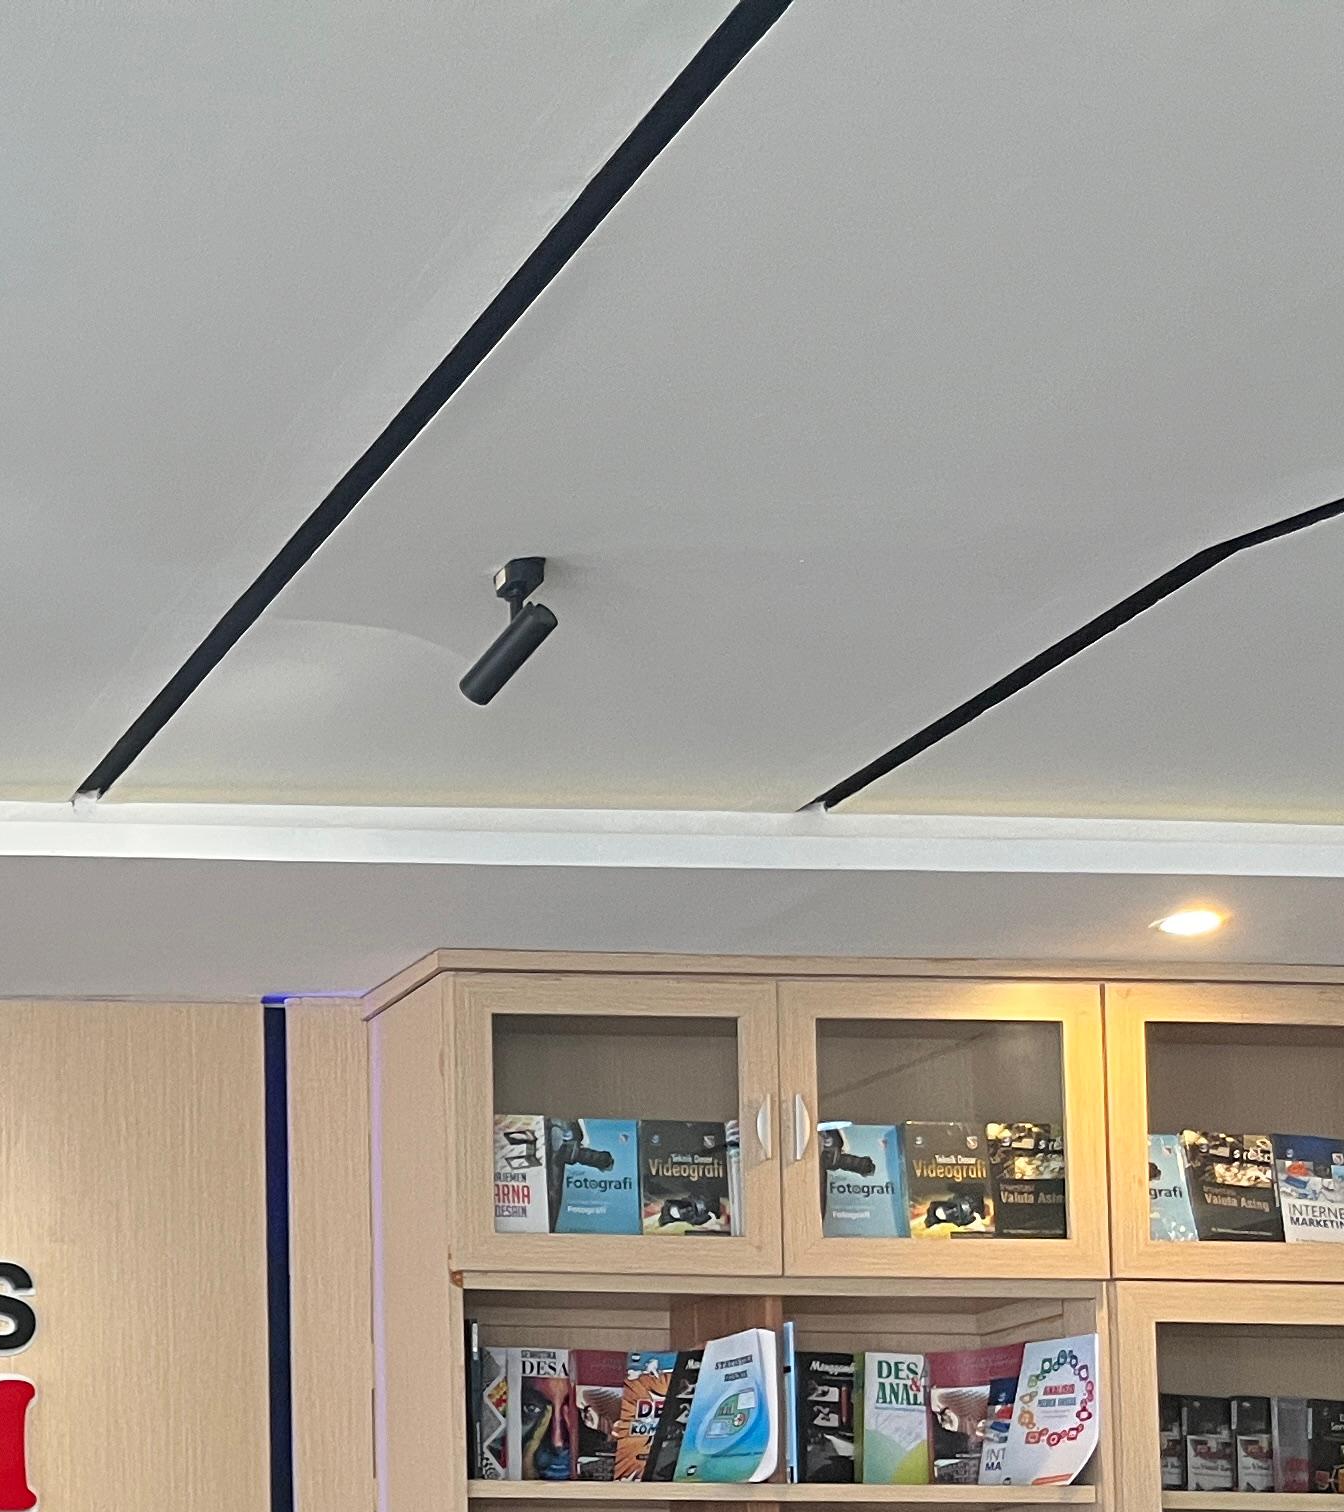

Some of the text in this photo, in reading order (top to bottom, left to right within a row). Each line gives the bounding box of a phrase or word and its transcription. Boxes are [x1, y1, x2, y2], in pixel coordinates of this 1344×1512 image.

[648, 1157, 724, 1180] Videografi
[913, 1159, 987, 1181] Videografi
[566, 1176, 633, 1193] Fotografi
[829, 1181, 895, 1198] Fotografi
[1149, 1186, 1182, 1200] grafi
[1288, 1203, 1344, 1220] INTERNE
[521, 1360, 570, 1376] DESA
